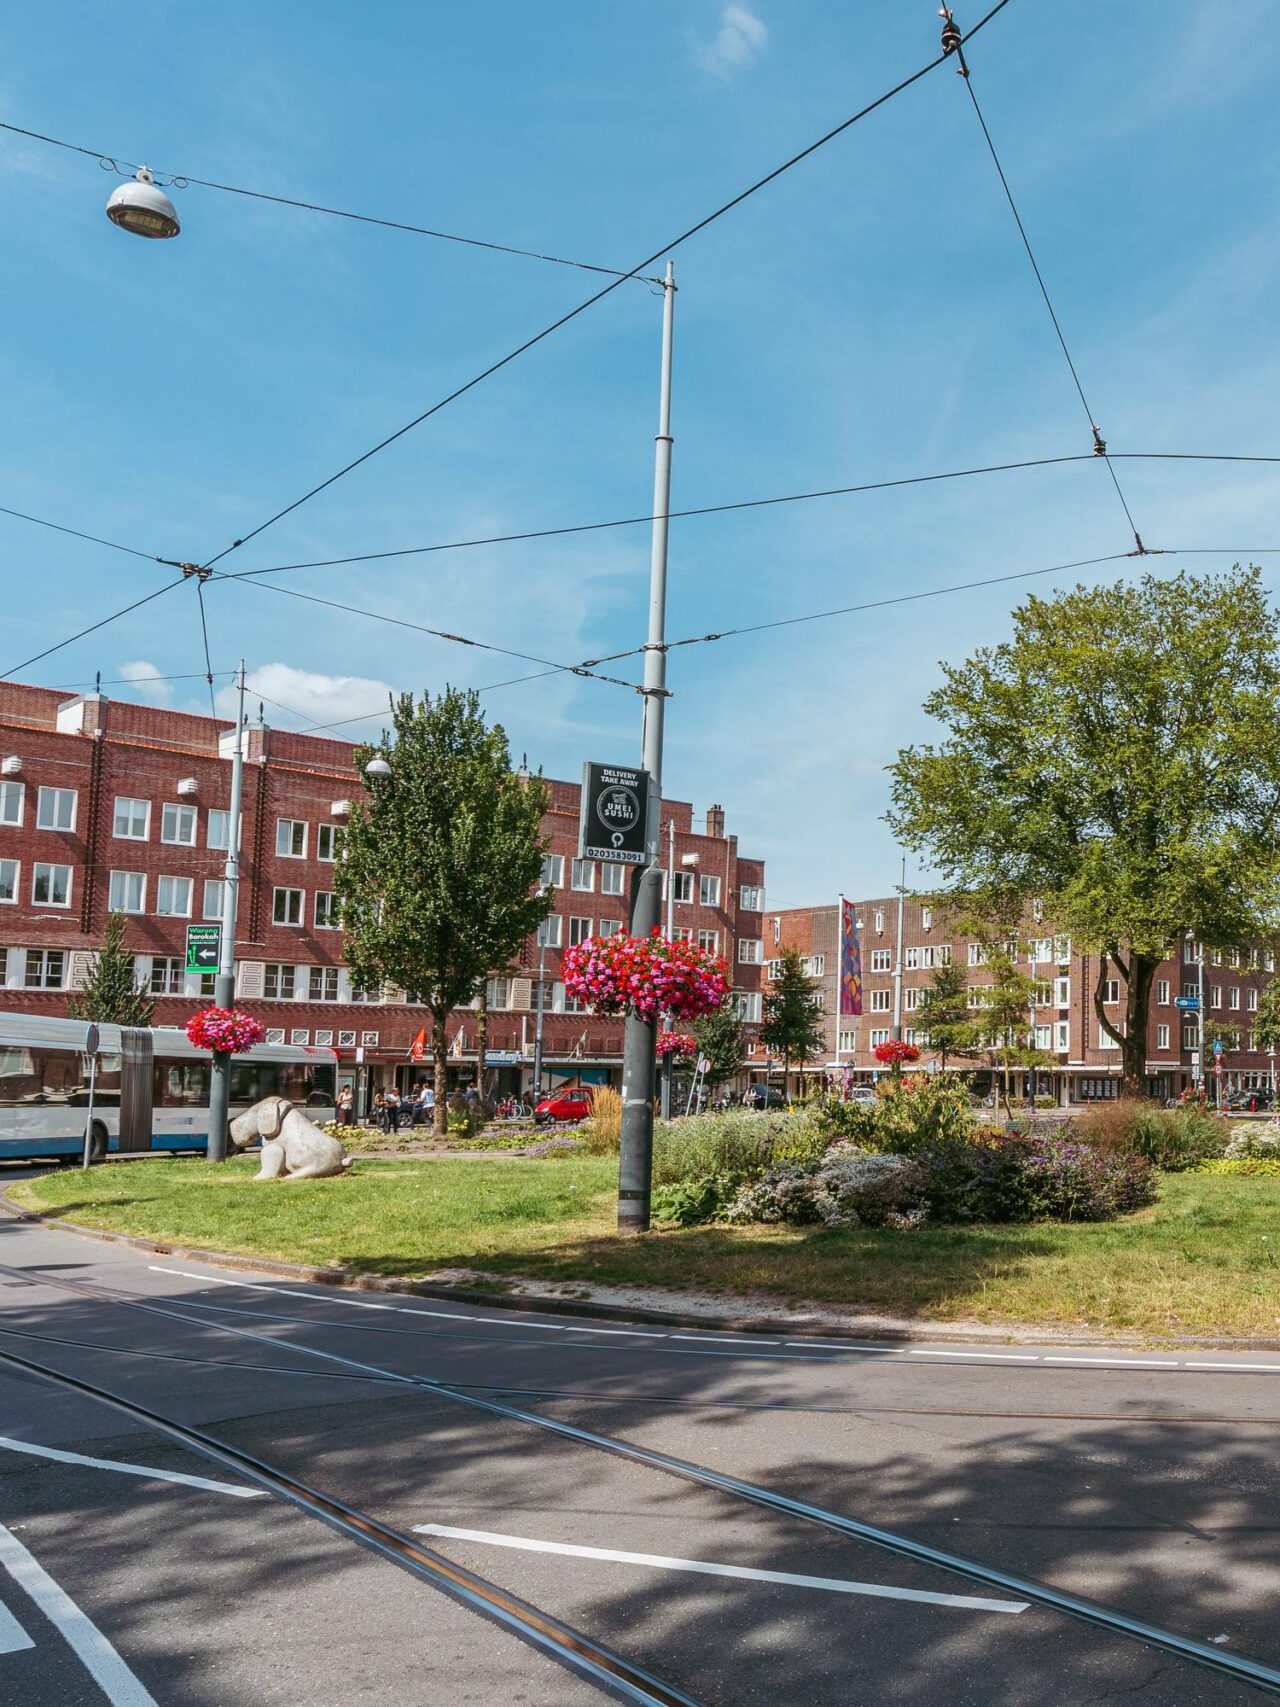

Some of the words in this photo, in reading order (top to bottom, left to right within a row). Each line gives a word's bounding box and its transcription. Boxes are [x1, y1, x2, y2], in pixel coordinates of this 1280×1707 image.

[603, 769, 637, 780] DELIVERY
[600, 776, 618, 784] TAKE
[619, 779, 639, 787] AWAY
[607, 803, 632, 812] UMEI
[604, 809, 633, 819] SUSHI
[588, 849, 642, 862] 0203583091
